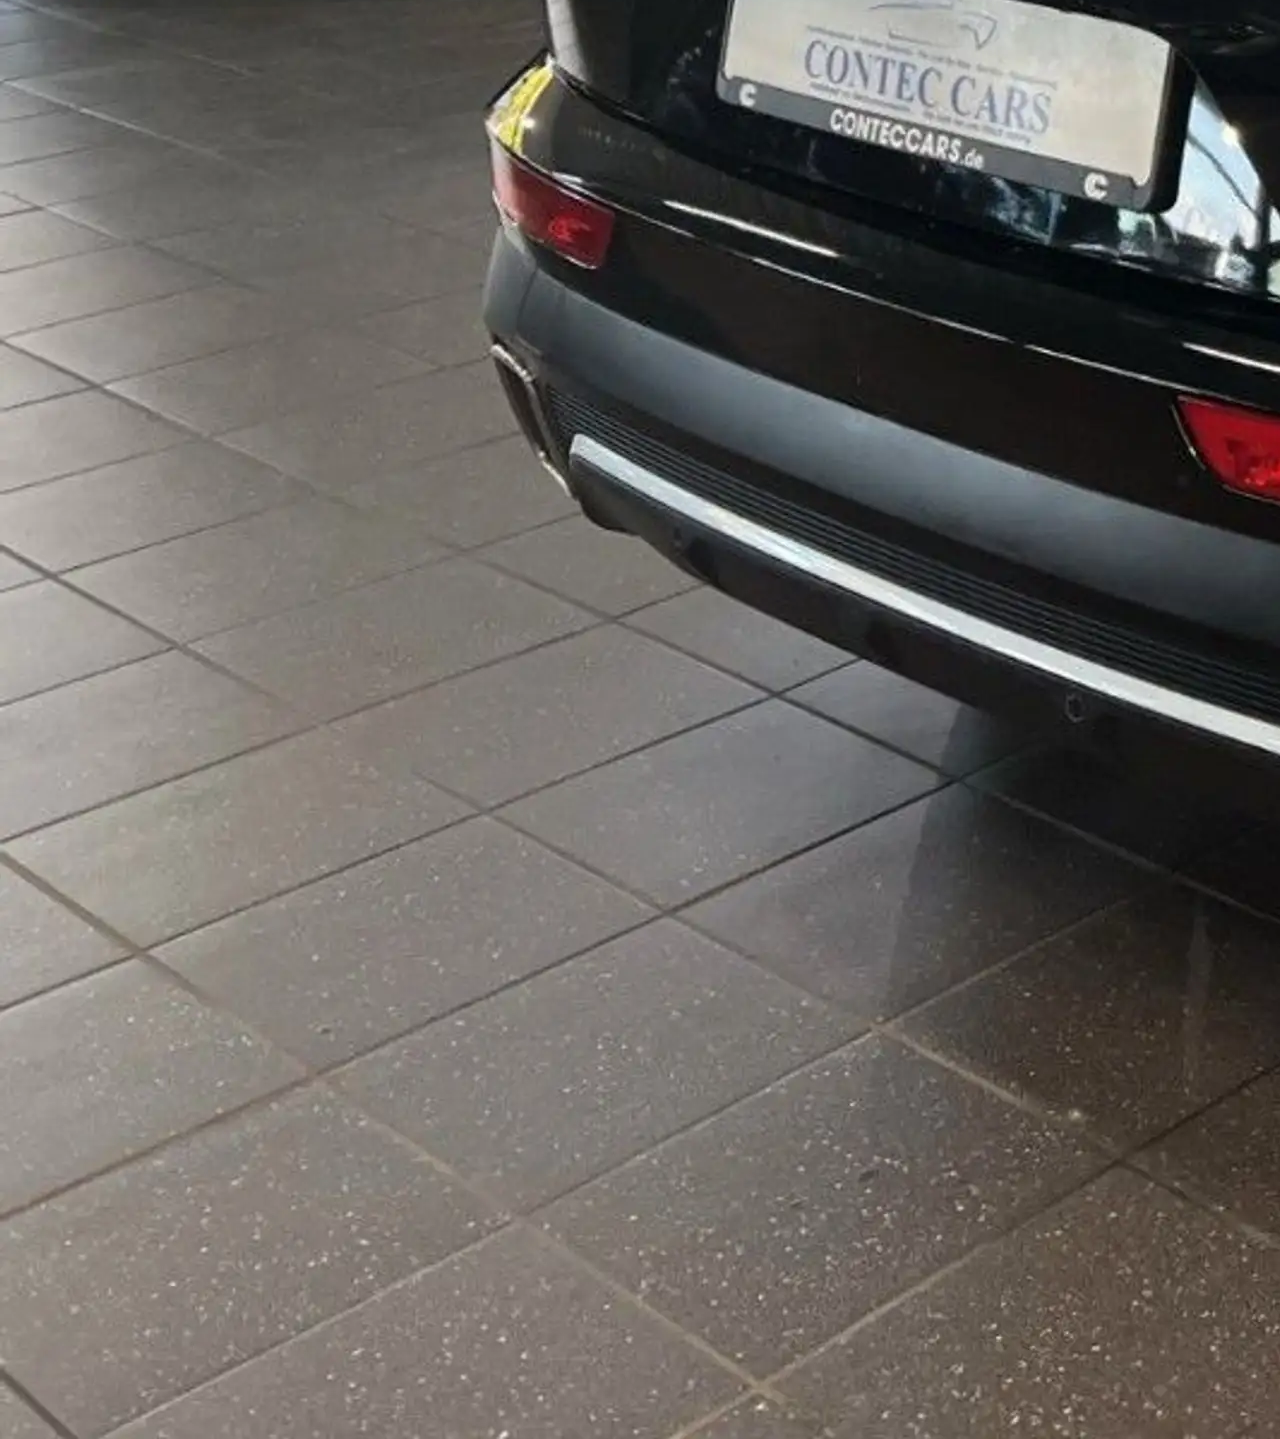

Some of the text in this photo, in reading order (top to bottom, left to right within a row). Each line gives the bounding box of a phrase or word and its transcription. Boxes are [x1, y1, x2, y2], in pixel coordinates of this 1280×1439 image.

[804, 39, 943, 109] CONTEC
[951, 74, 1053, 135] CARS
[829, 108, 986, 171] CONTECCARS.de
